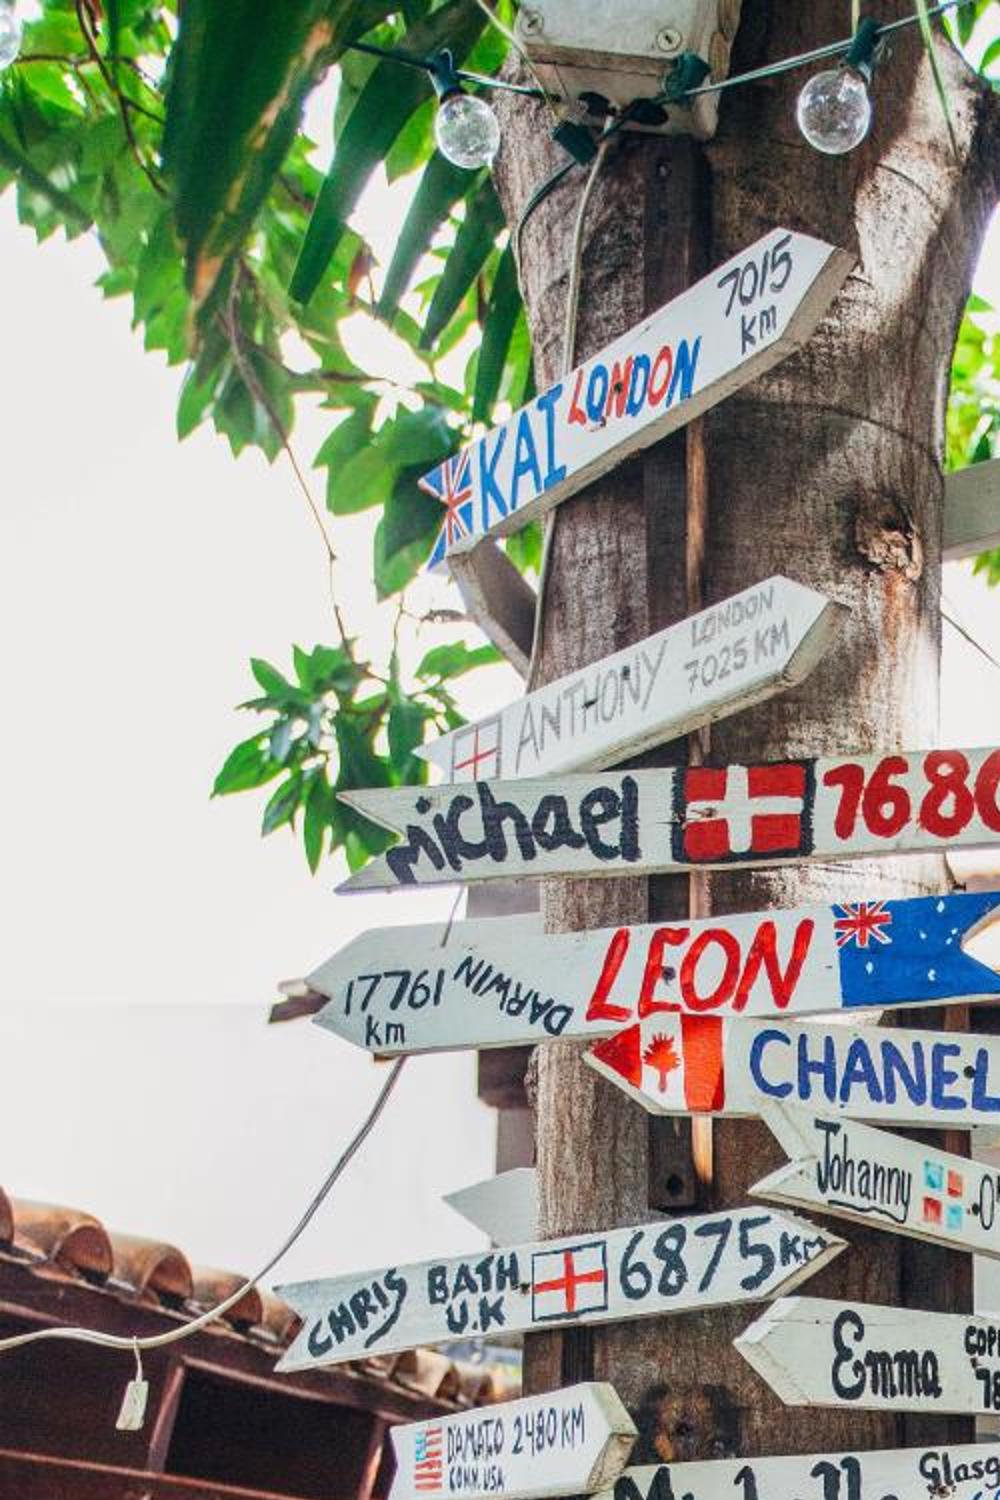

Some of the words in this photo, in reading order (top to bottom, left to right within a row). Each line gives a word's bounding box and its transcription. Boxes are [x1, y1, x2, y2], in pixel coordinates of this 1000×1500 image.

[717, 235, 793, 318] 7015
[478, 383, 567, 531] KAI
[567, 336, 702, 432] LONDON
[683, 635, 748, 693] 7025
[755, 617, 791, 655] KM
[691, 585, 775, 647] LONDON
[515, 638, 668, 774] ANTHONY
[344, 970, 446, 1016] 17761
[453, 955, 575, 1037] DARWIN
[586, 920, 815, 1022] LEON
[364, 1015, 406, 1047] km
[813, 1117, 913, 1222] Johanny
[308, 1268, 408, 1358] CHRIS
[618, 1215, 776, 1300] 6875
[427, 1251, 519, 1305] BATH
[831, 1309, 943, 1400] Emma
[483, 1465, 506, 1492] USA
